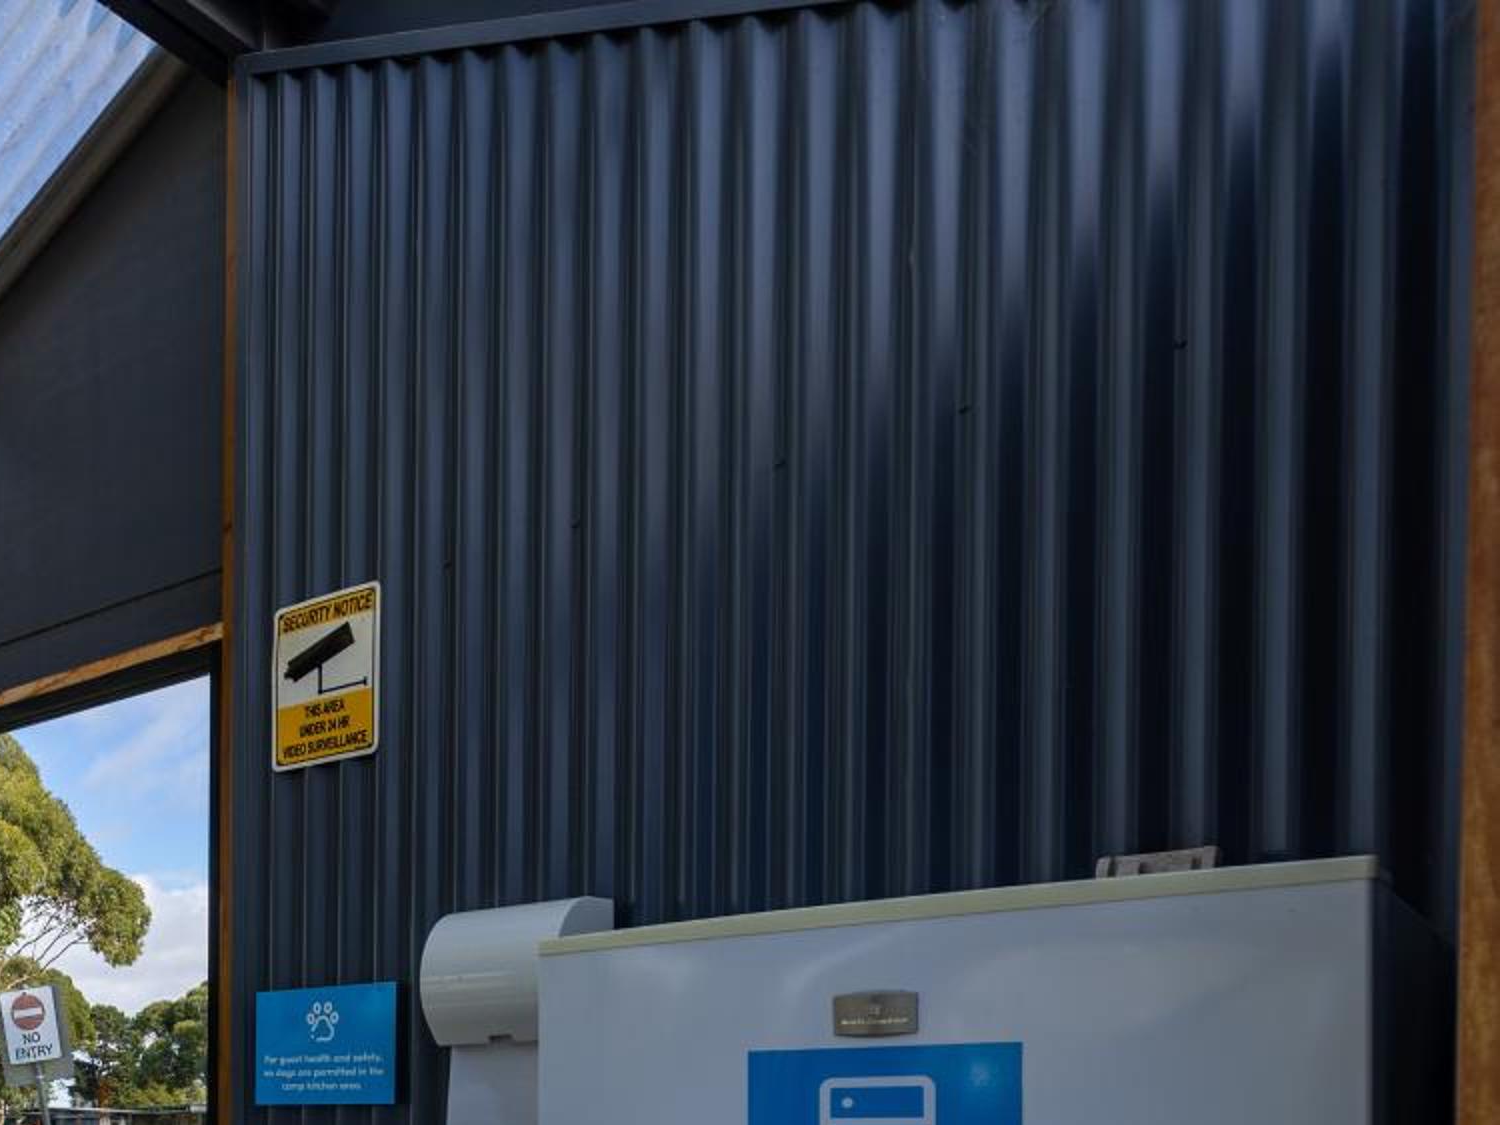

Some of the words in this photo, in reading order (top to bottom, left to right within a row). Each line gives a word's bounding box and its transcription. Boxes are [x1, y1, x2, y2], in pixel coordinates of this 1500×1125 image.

[283, 606, 330, 633] SECURITY
[334, 593, 372, 618] NOTICE
[22, 1031, 41, 1044] NO
[16, 1043, 52, 1059] ENTRY
